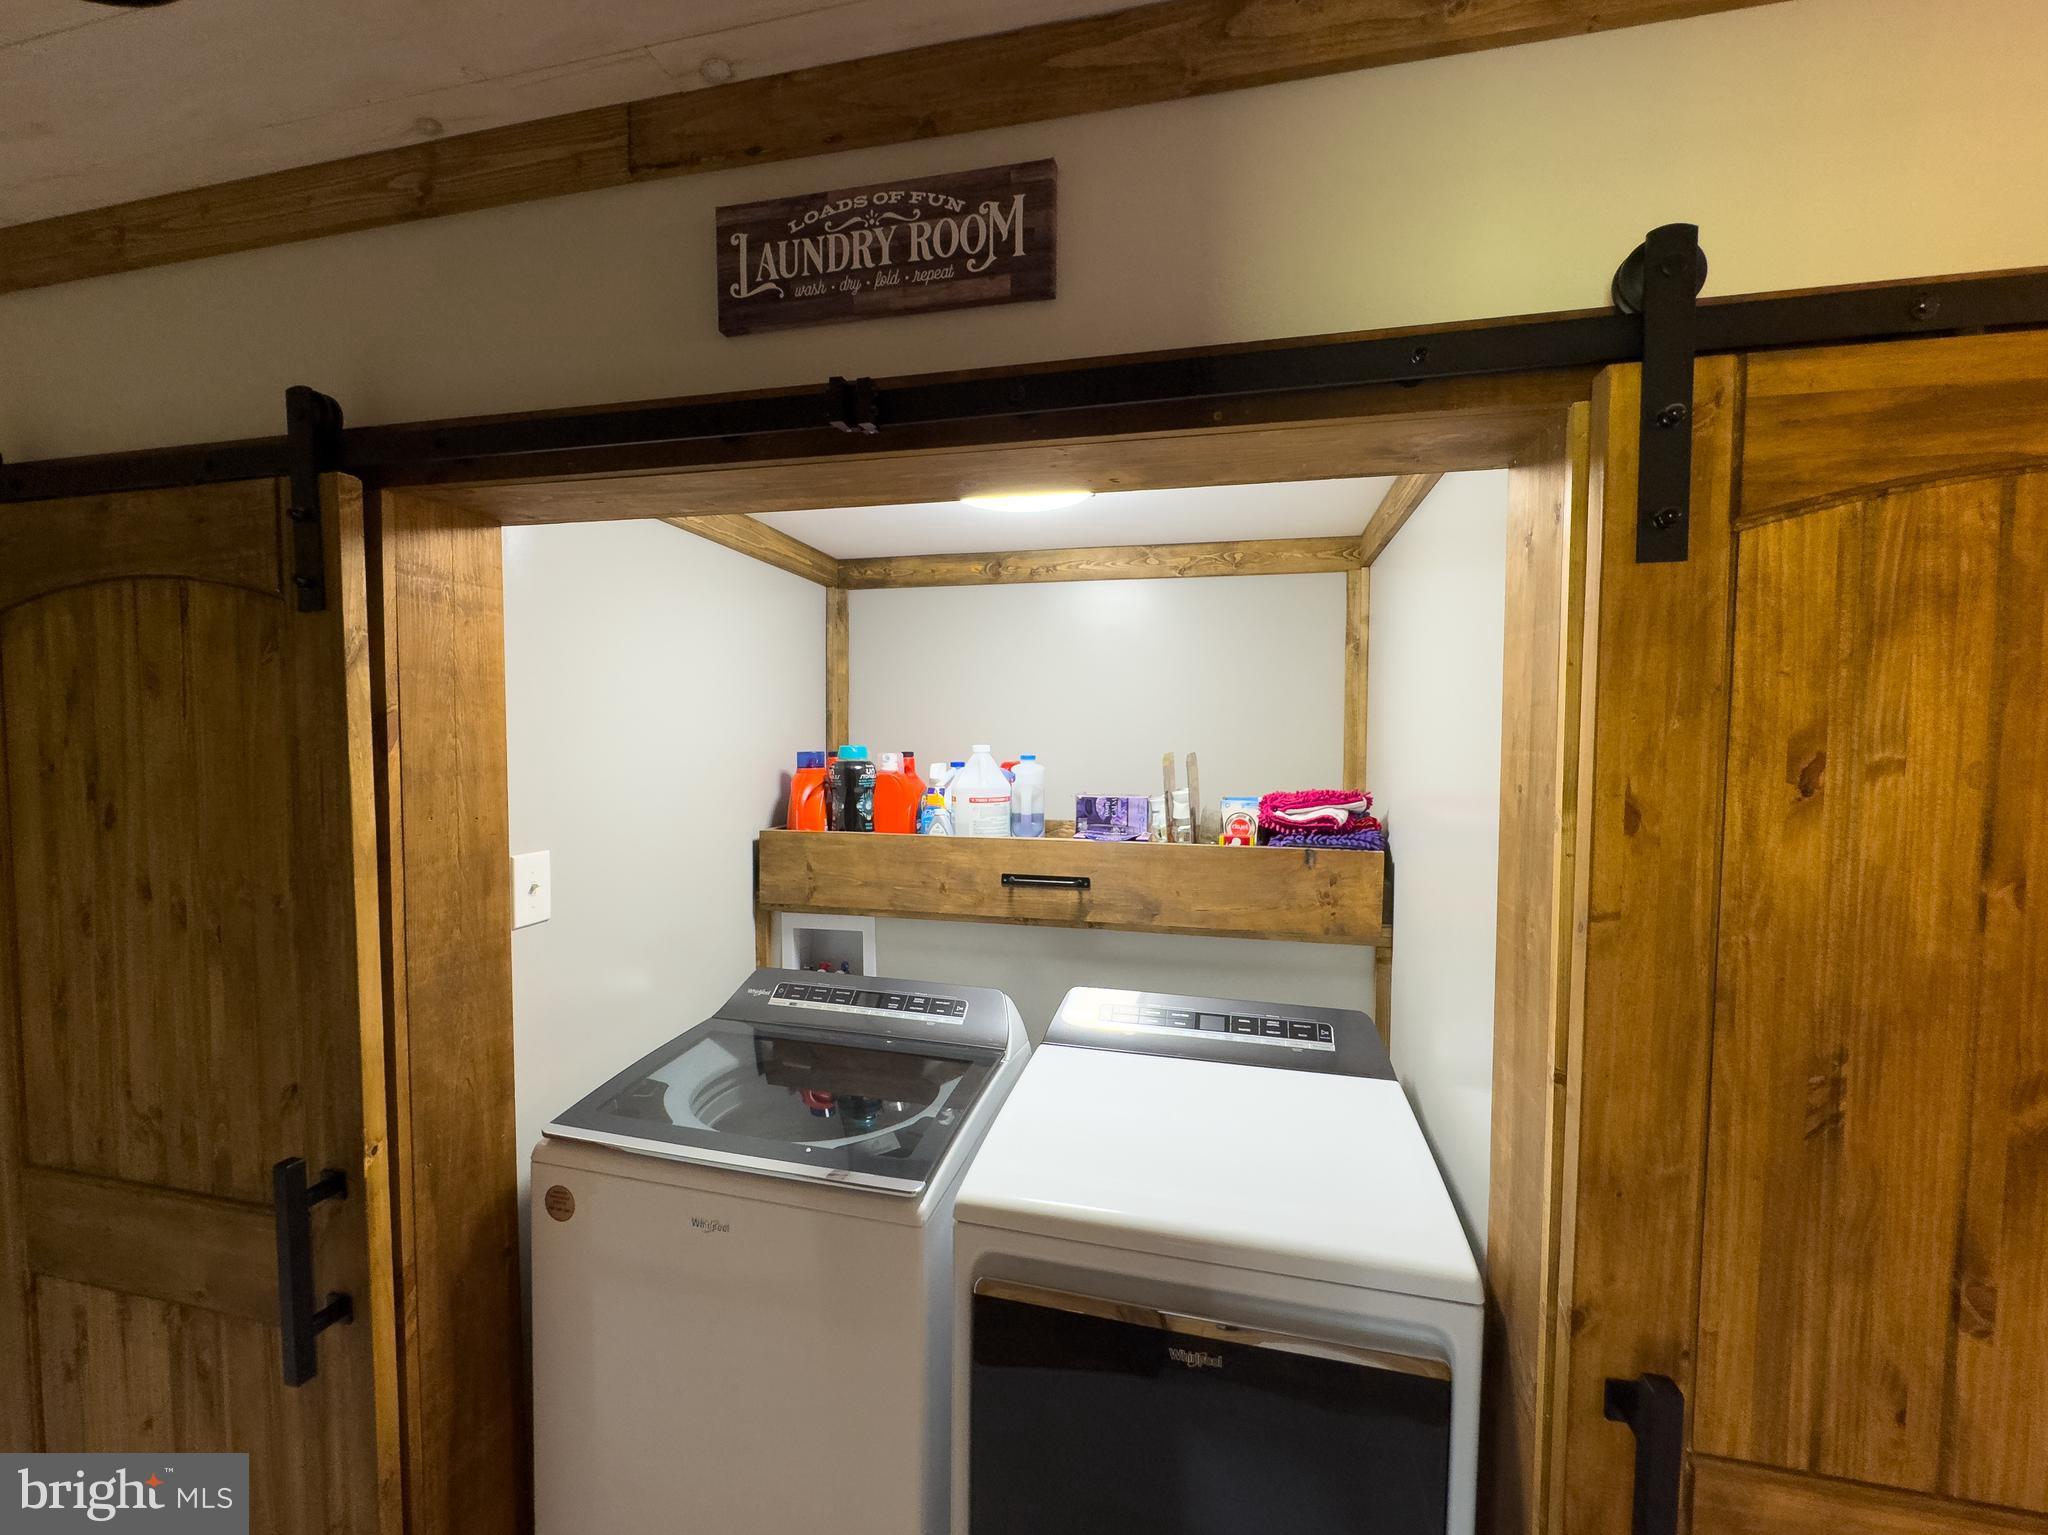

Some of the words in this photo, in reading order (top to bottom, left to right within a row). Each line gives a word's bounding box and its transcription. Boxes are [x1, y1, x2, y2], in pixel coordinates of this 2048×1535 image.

[787, 195, 868, 234] LOADS
[873, 191, 905, 205] OF
[909, 191, 966, 214] FUN
[730, 225, 898, 298] LAUNDRY
[907, 193, 1027, 272] ROOM
[794, 279, 827, 297] wash
[839, 276, 862, 296] dry
[874, 269, 900, 289] fold
[911, 264, 955, 285] repeat
